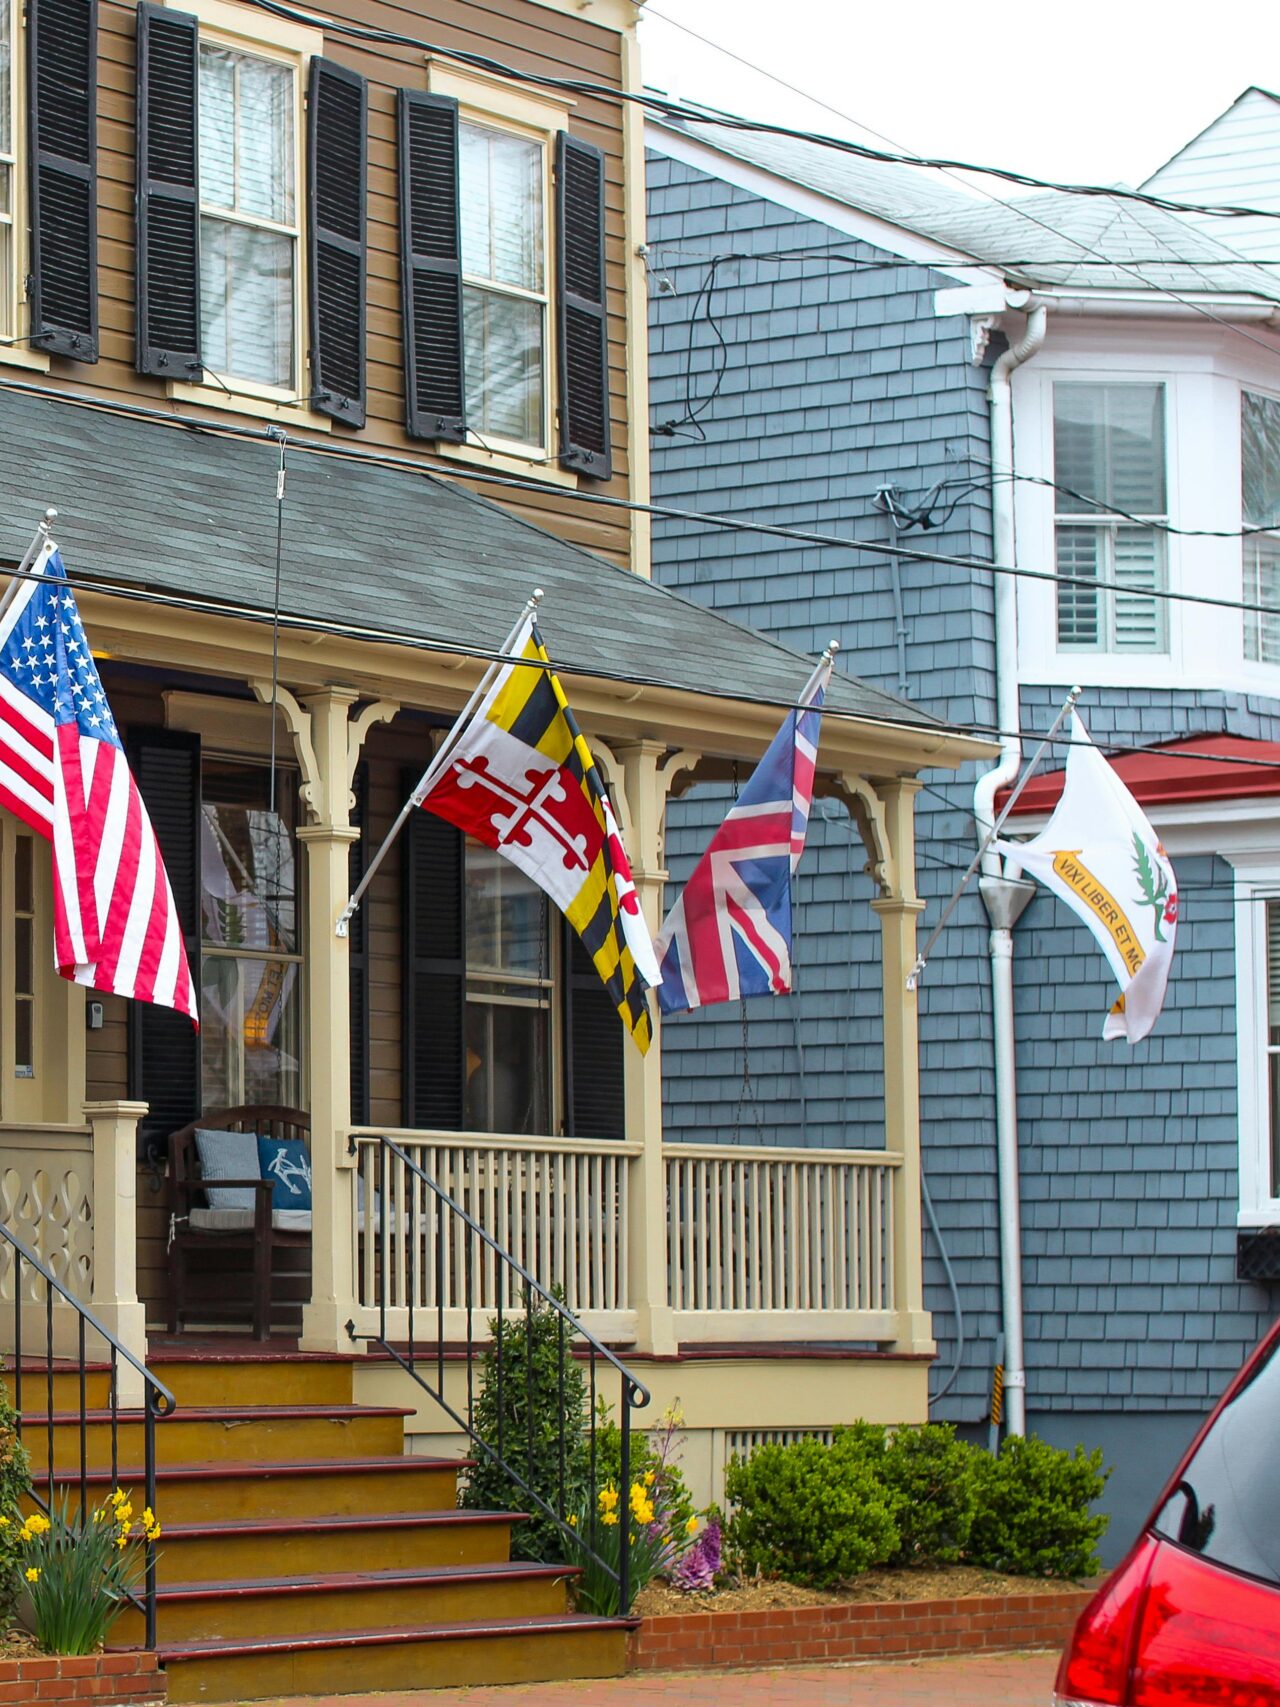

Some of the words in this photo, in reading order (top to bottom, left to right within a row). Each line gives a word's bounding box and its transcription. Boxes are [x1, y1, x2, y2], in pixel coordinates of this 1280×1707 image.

[1060, 858, 1085, 886] VIXI
[1081, 881, 1118, 925] LIBER
[1115, 924, 1132, 945] ET
